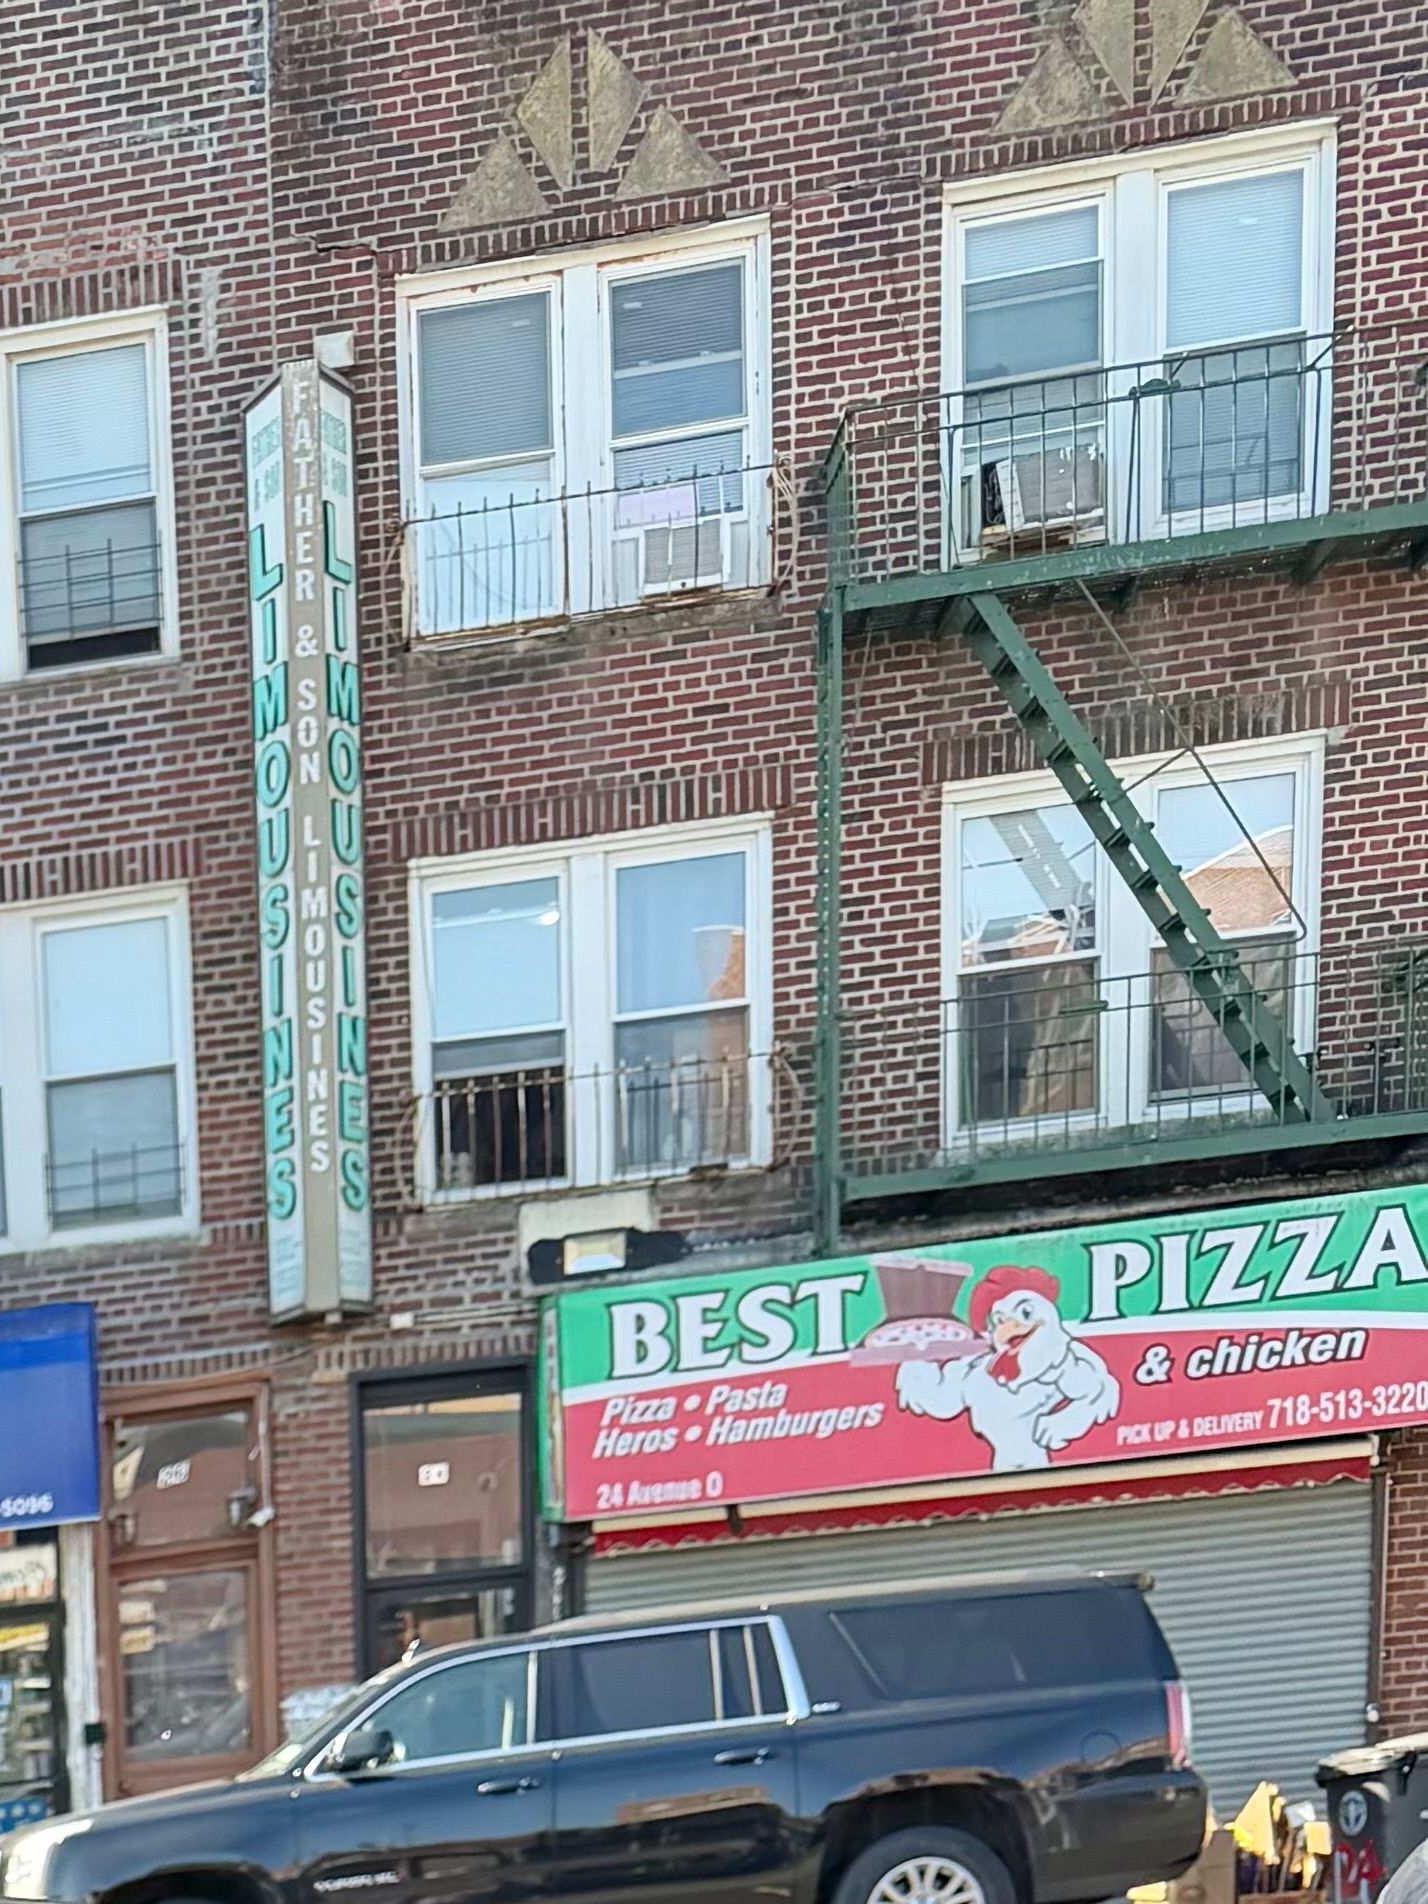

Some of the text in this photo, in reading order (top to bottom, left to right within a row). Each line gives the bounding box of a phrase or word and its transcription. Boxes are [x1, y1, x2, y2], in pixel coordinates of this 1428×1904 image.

[294, 380, 332, 1173] FATHER & SON LIMOUSINES
[249, 522, 297, 1221] LIMOUSINES
[323, 499, 369, 1213] LIMOUSINES
[1080, 1203, 1428, 1324] PIZZA
[608, 1270, 869, 1380] BEST
[1134, 1327, 1370, 1385] & chicken
[591, 1401, 886, 1459] Heros Hamburgers
[600, 1380, 789, 1427] Pizza Pasta
[1116, 1380, 1428, 1447] PICK UP & DELIVERY 718-513-3220
[596, 1483, 624, 1510] 24
[627, 1478, 703, 1506] Avenue
